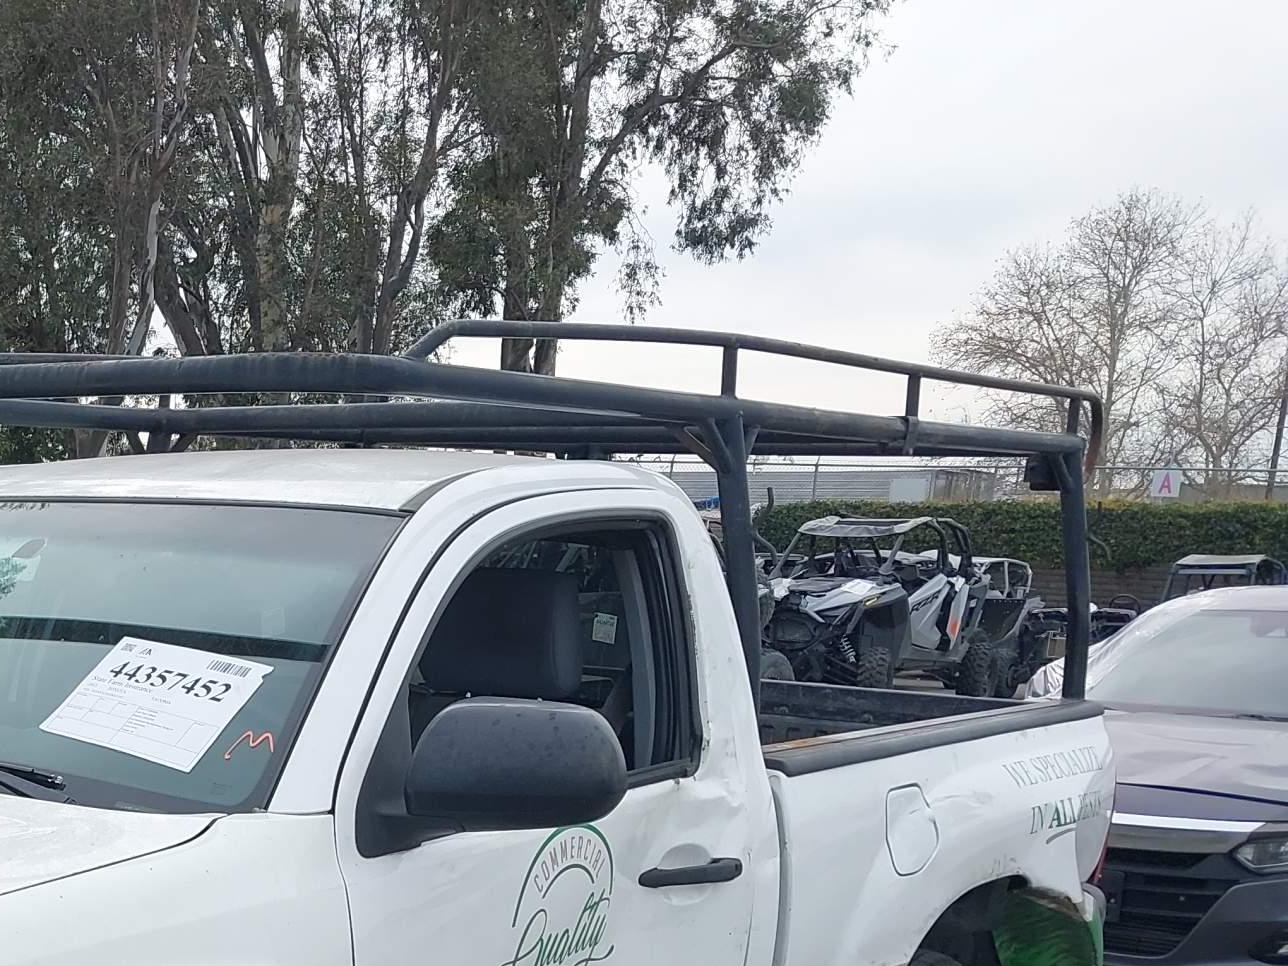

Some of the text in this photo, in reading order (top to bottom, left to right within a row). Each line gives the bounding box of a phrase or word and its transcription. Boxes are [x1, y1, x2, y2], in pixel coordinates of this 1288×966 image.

[1158, 471, 1172, 494] A
[110, 661, 232, 703] 44357452
[1002, 760, 1038, 789] WE
[1048, 797, 1077, 829] ALL
[534, 836, 606, 893] COMMERCIAL
